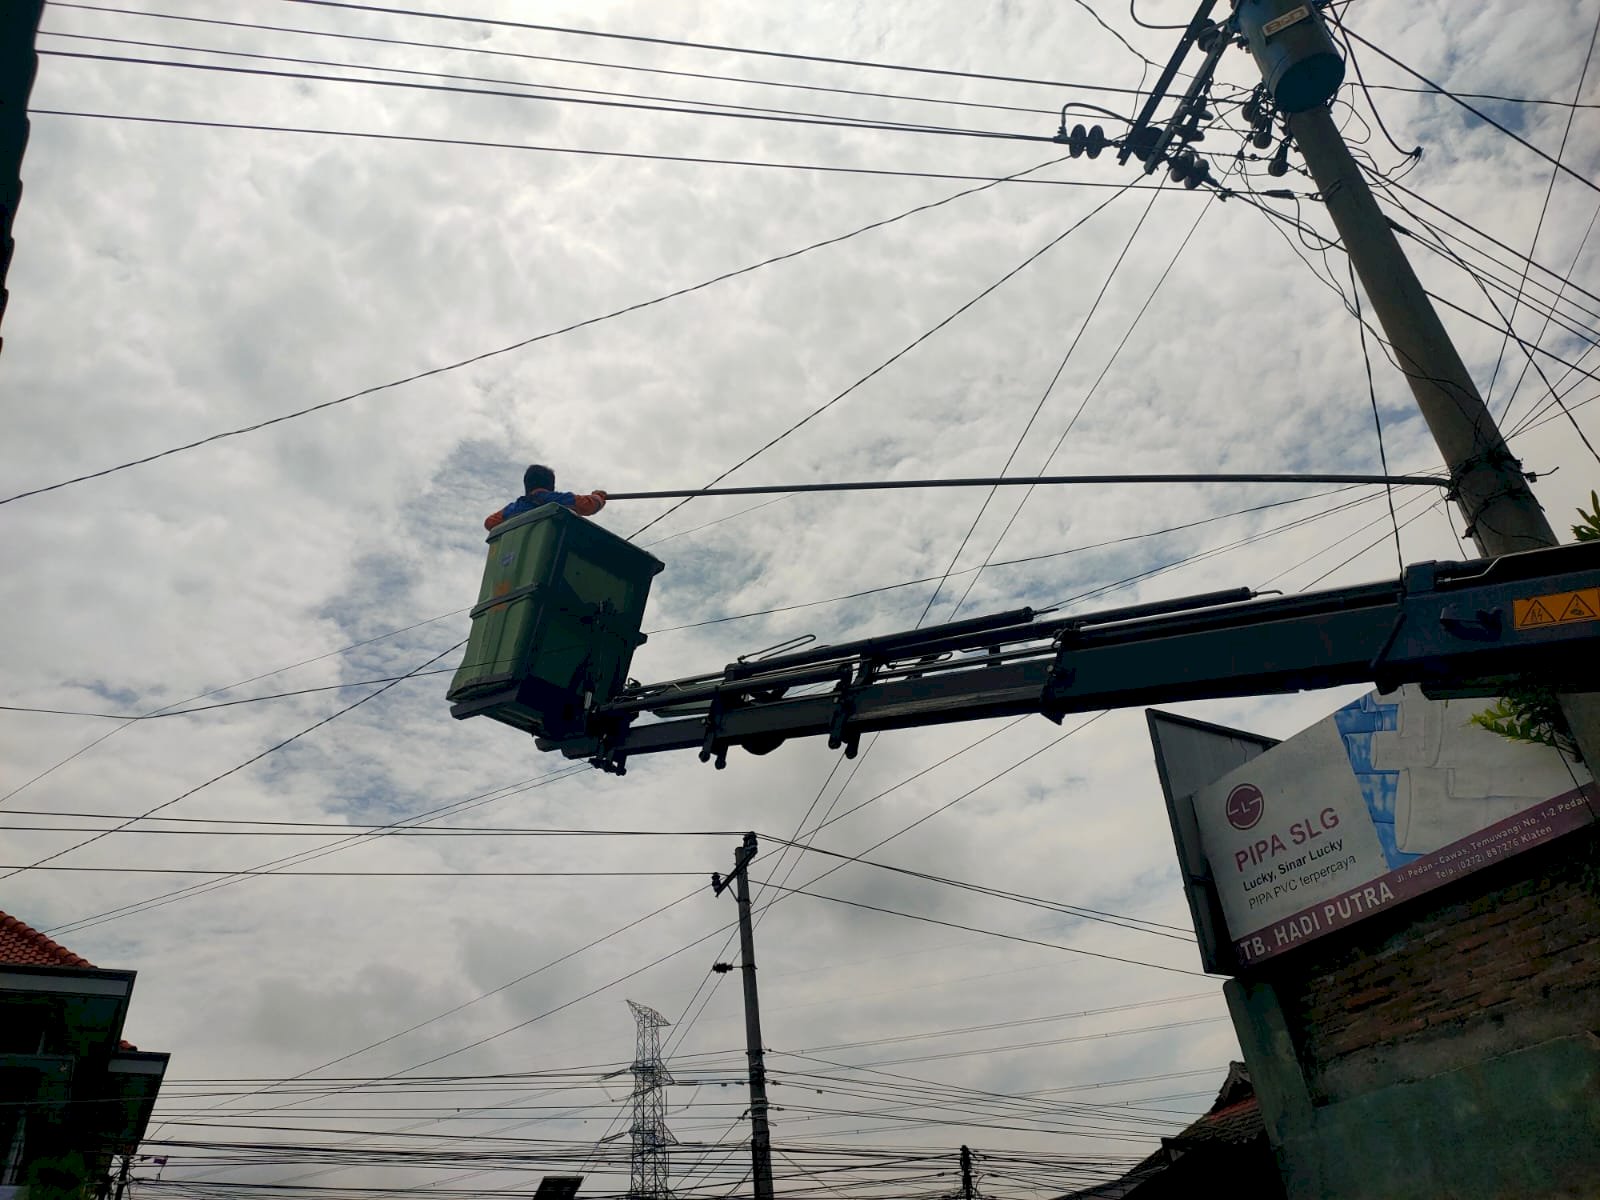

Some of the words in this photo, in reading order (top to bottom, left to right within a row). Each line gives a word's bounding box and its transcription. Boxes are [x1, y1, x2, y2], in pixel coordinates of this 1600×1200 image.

[1235, 834, 1287, 872] PIPA
[1289, 808, 1339, 845] SLG
[1407, 863, 1433, 879] Pedan
[1470, 823, 1522, 850] Temuwangi
[1522, 817, 1540, 828] No.
[1520, 825, 1553, 843] Klaten
[1243, 871, 1277, 892] Lucky,
[1278, 856, 1307, 875] Sinar
[1308, 838, 1343, 861] Lucky
[1248, 891, 1273, 910] PIPA
[1273, 880, 1298, 898] PVC
[1299, 855, 1357, 887] terpercaya
[1240, 936, 1272, 960] TB.
[1273, 911, 1321, 946] HADI
[1324, 881, 1395, 925] PUTRA
